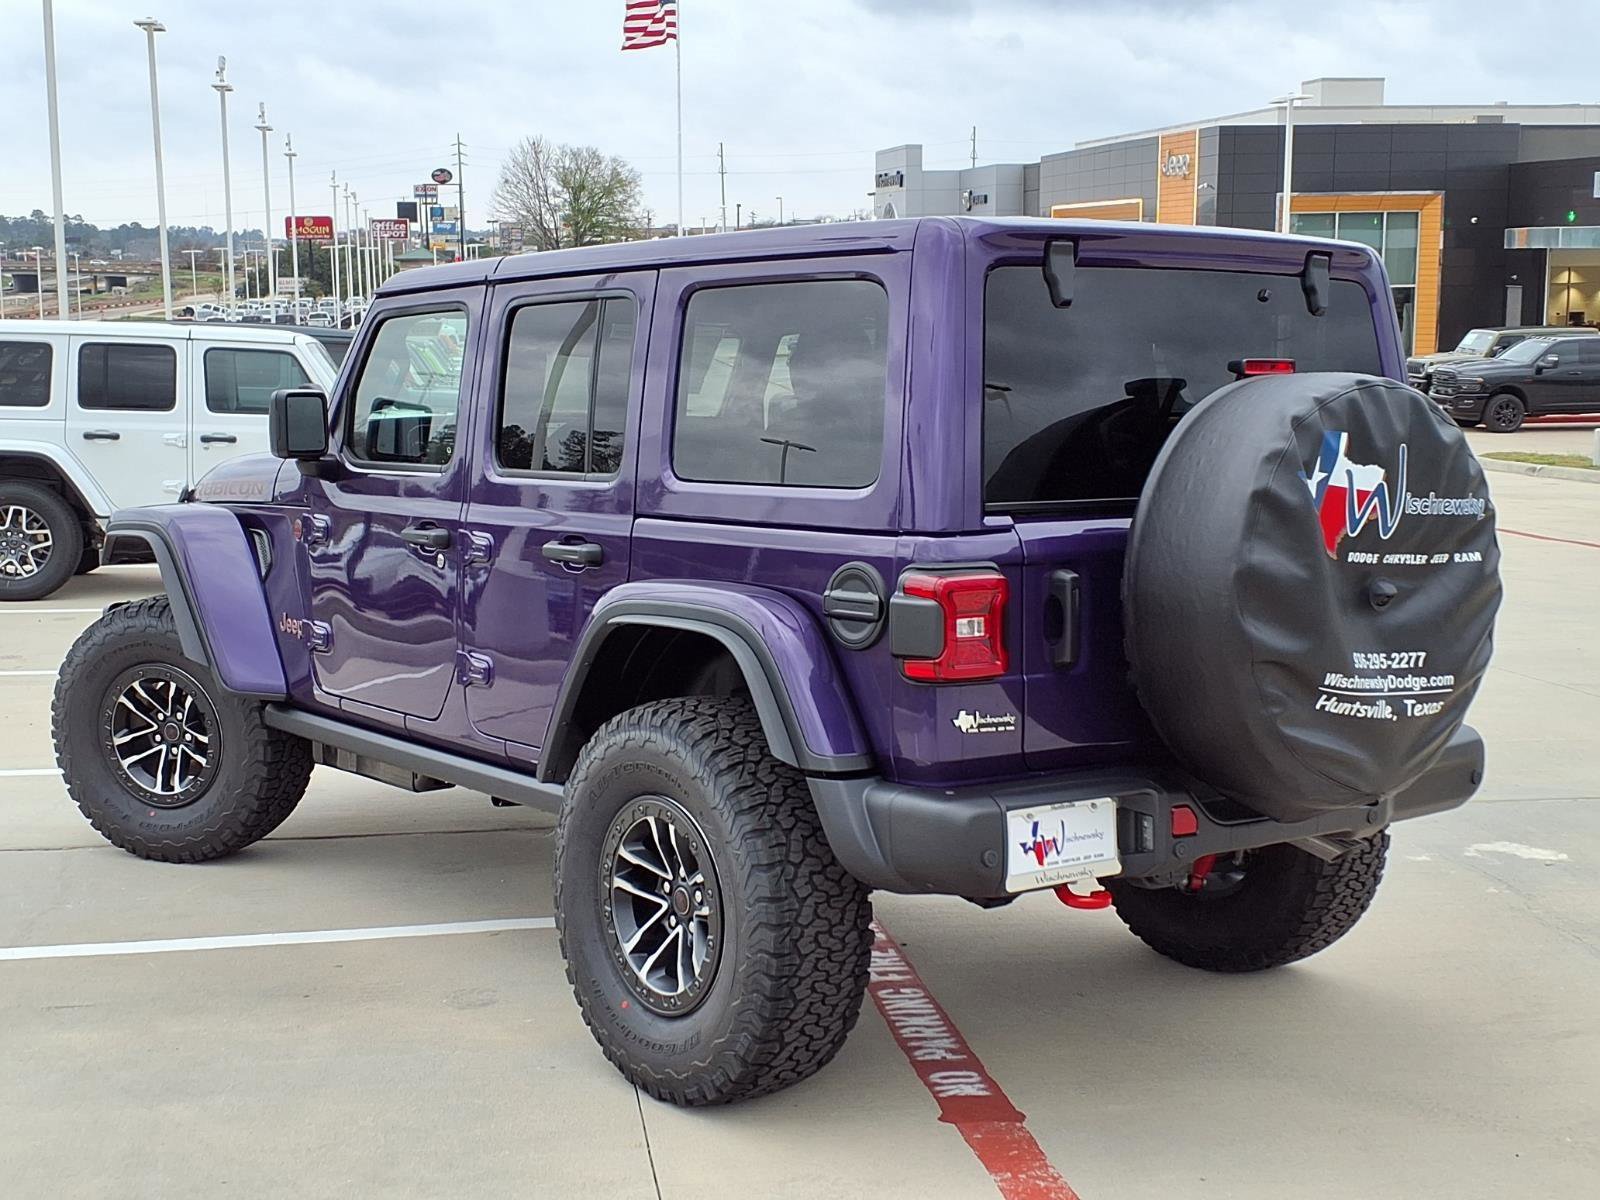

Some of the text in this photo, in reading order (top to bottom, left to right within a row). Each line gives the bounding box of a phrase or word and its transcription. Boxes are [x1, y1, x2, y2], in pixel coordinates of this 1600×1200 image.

[1161, 149, 1190, 178] Jeep
[372, 221, 407, 231] Office
[1347, 551, 1483, 565] DODGE CHRYSLER JEEP RAM
[279, 611, 303, 640] Jeep
[1315, 694, 1445, 721] Huntsville, Texas
[867, 947, 993, 1098] NO PARKING FIRE
